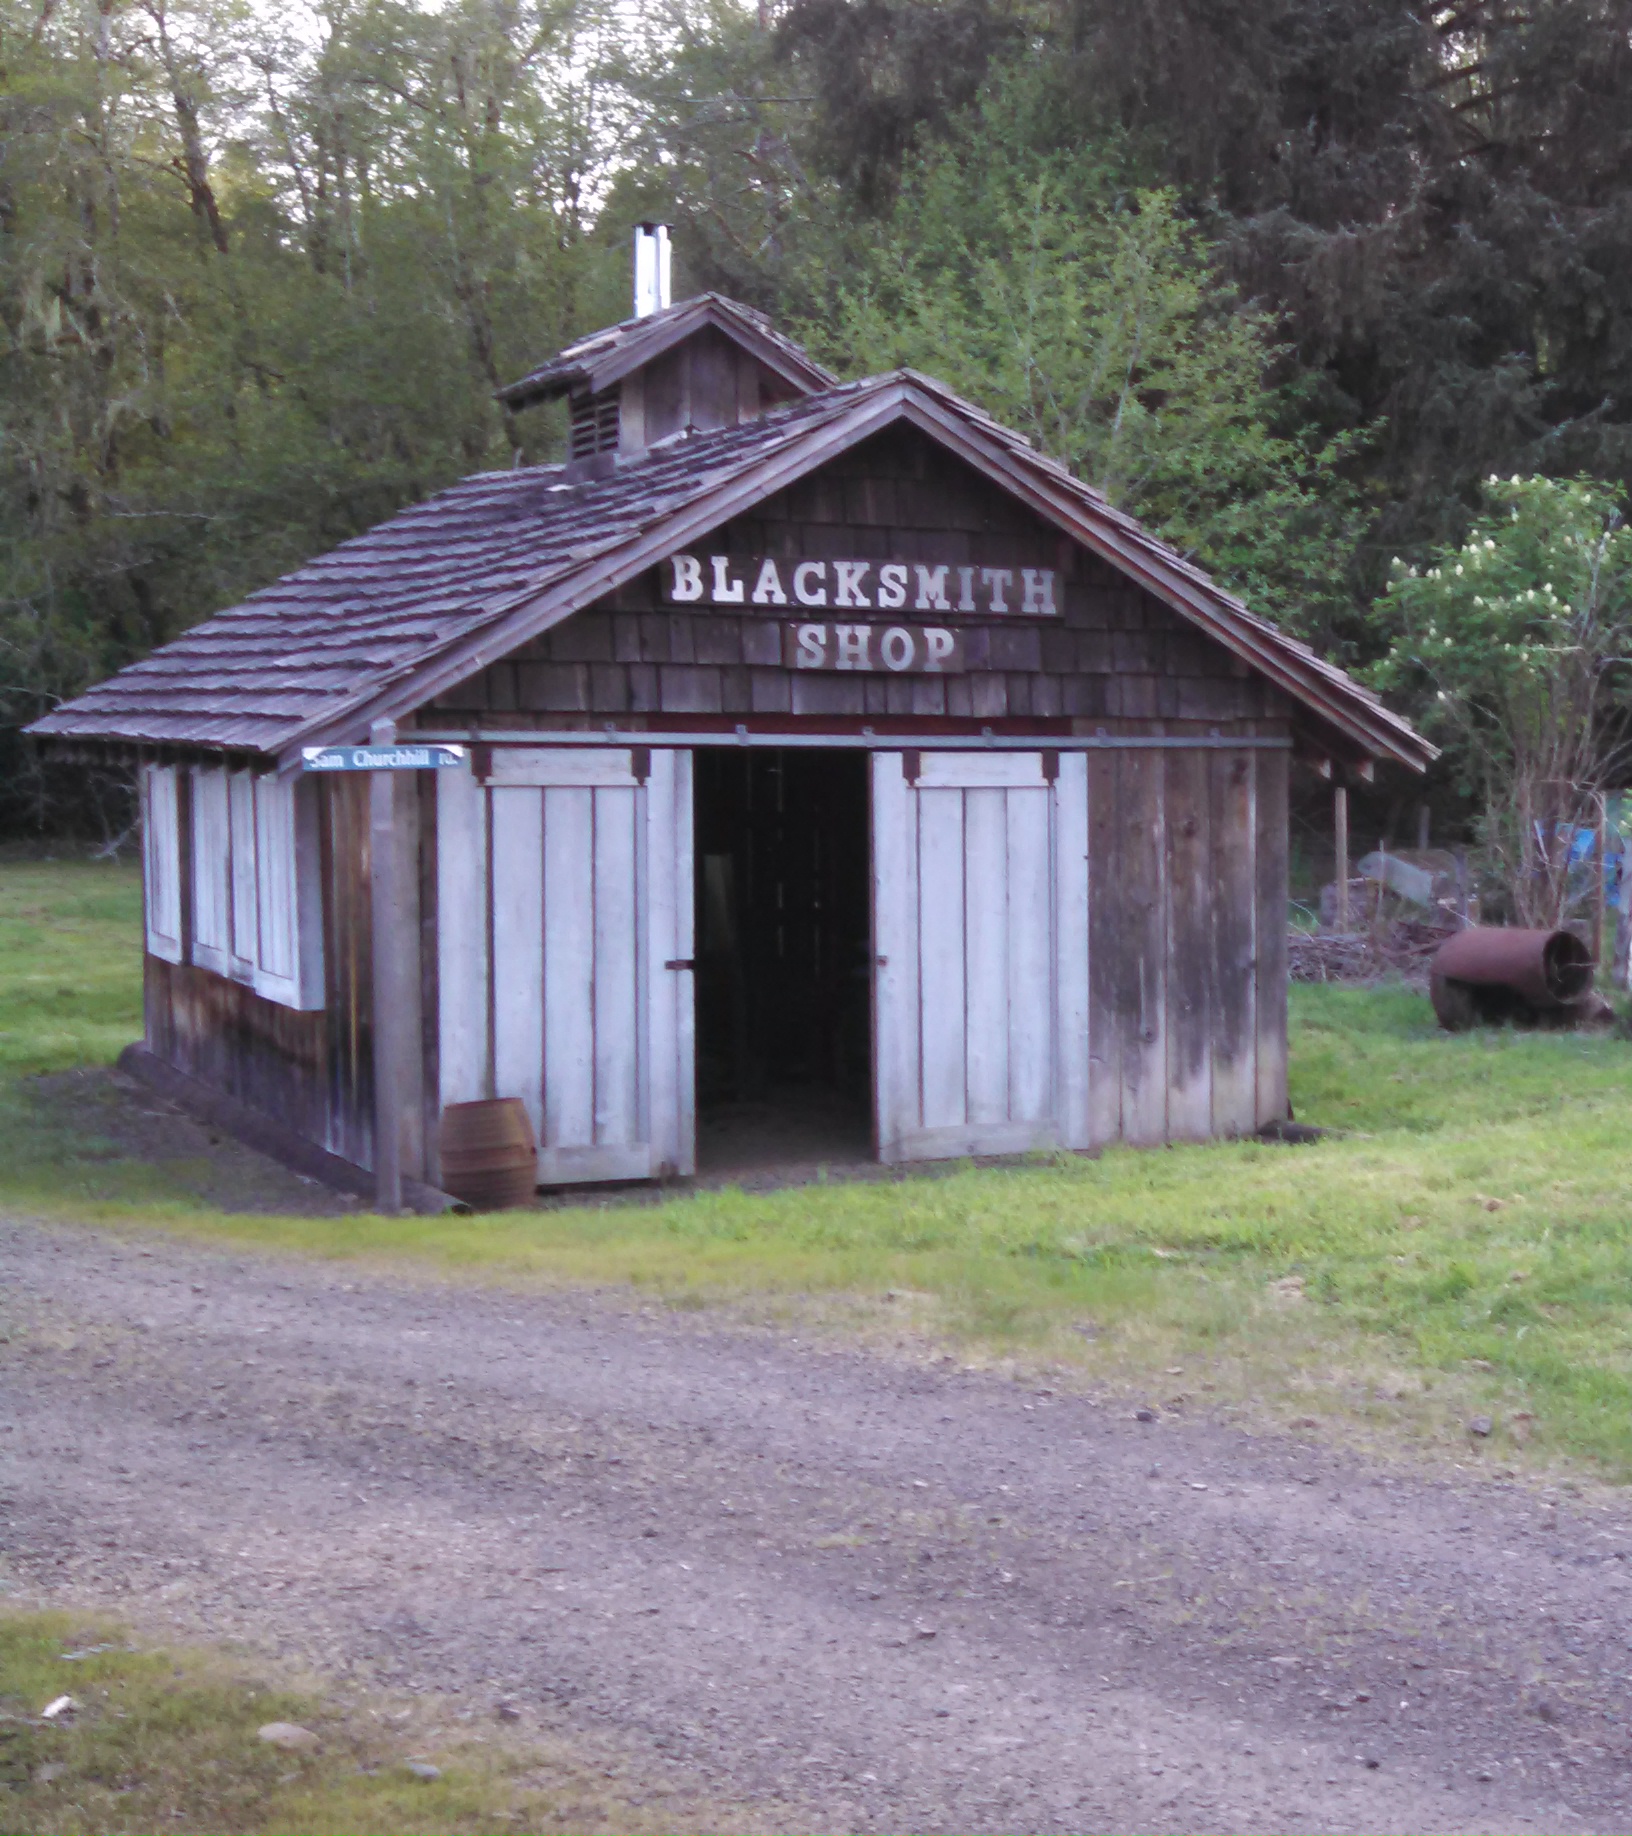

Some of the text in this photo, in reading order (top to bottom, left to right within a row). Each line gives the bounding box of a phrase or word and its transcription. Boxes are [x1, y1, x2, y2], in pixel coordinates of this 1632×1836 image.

[671, 554, 1057, 614] BLACKSMITH
[796, 623, 956, 672] SHOP
[310, 753, 344, 768] Sam
